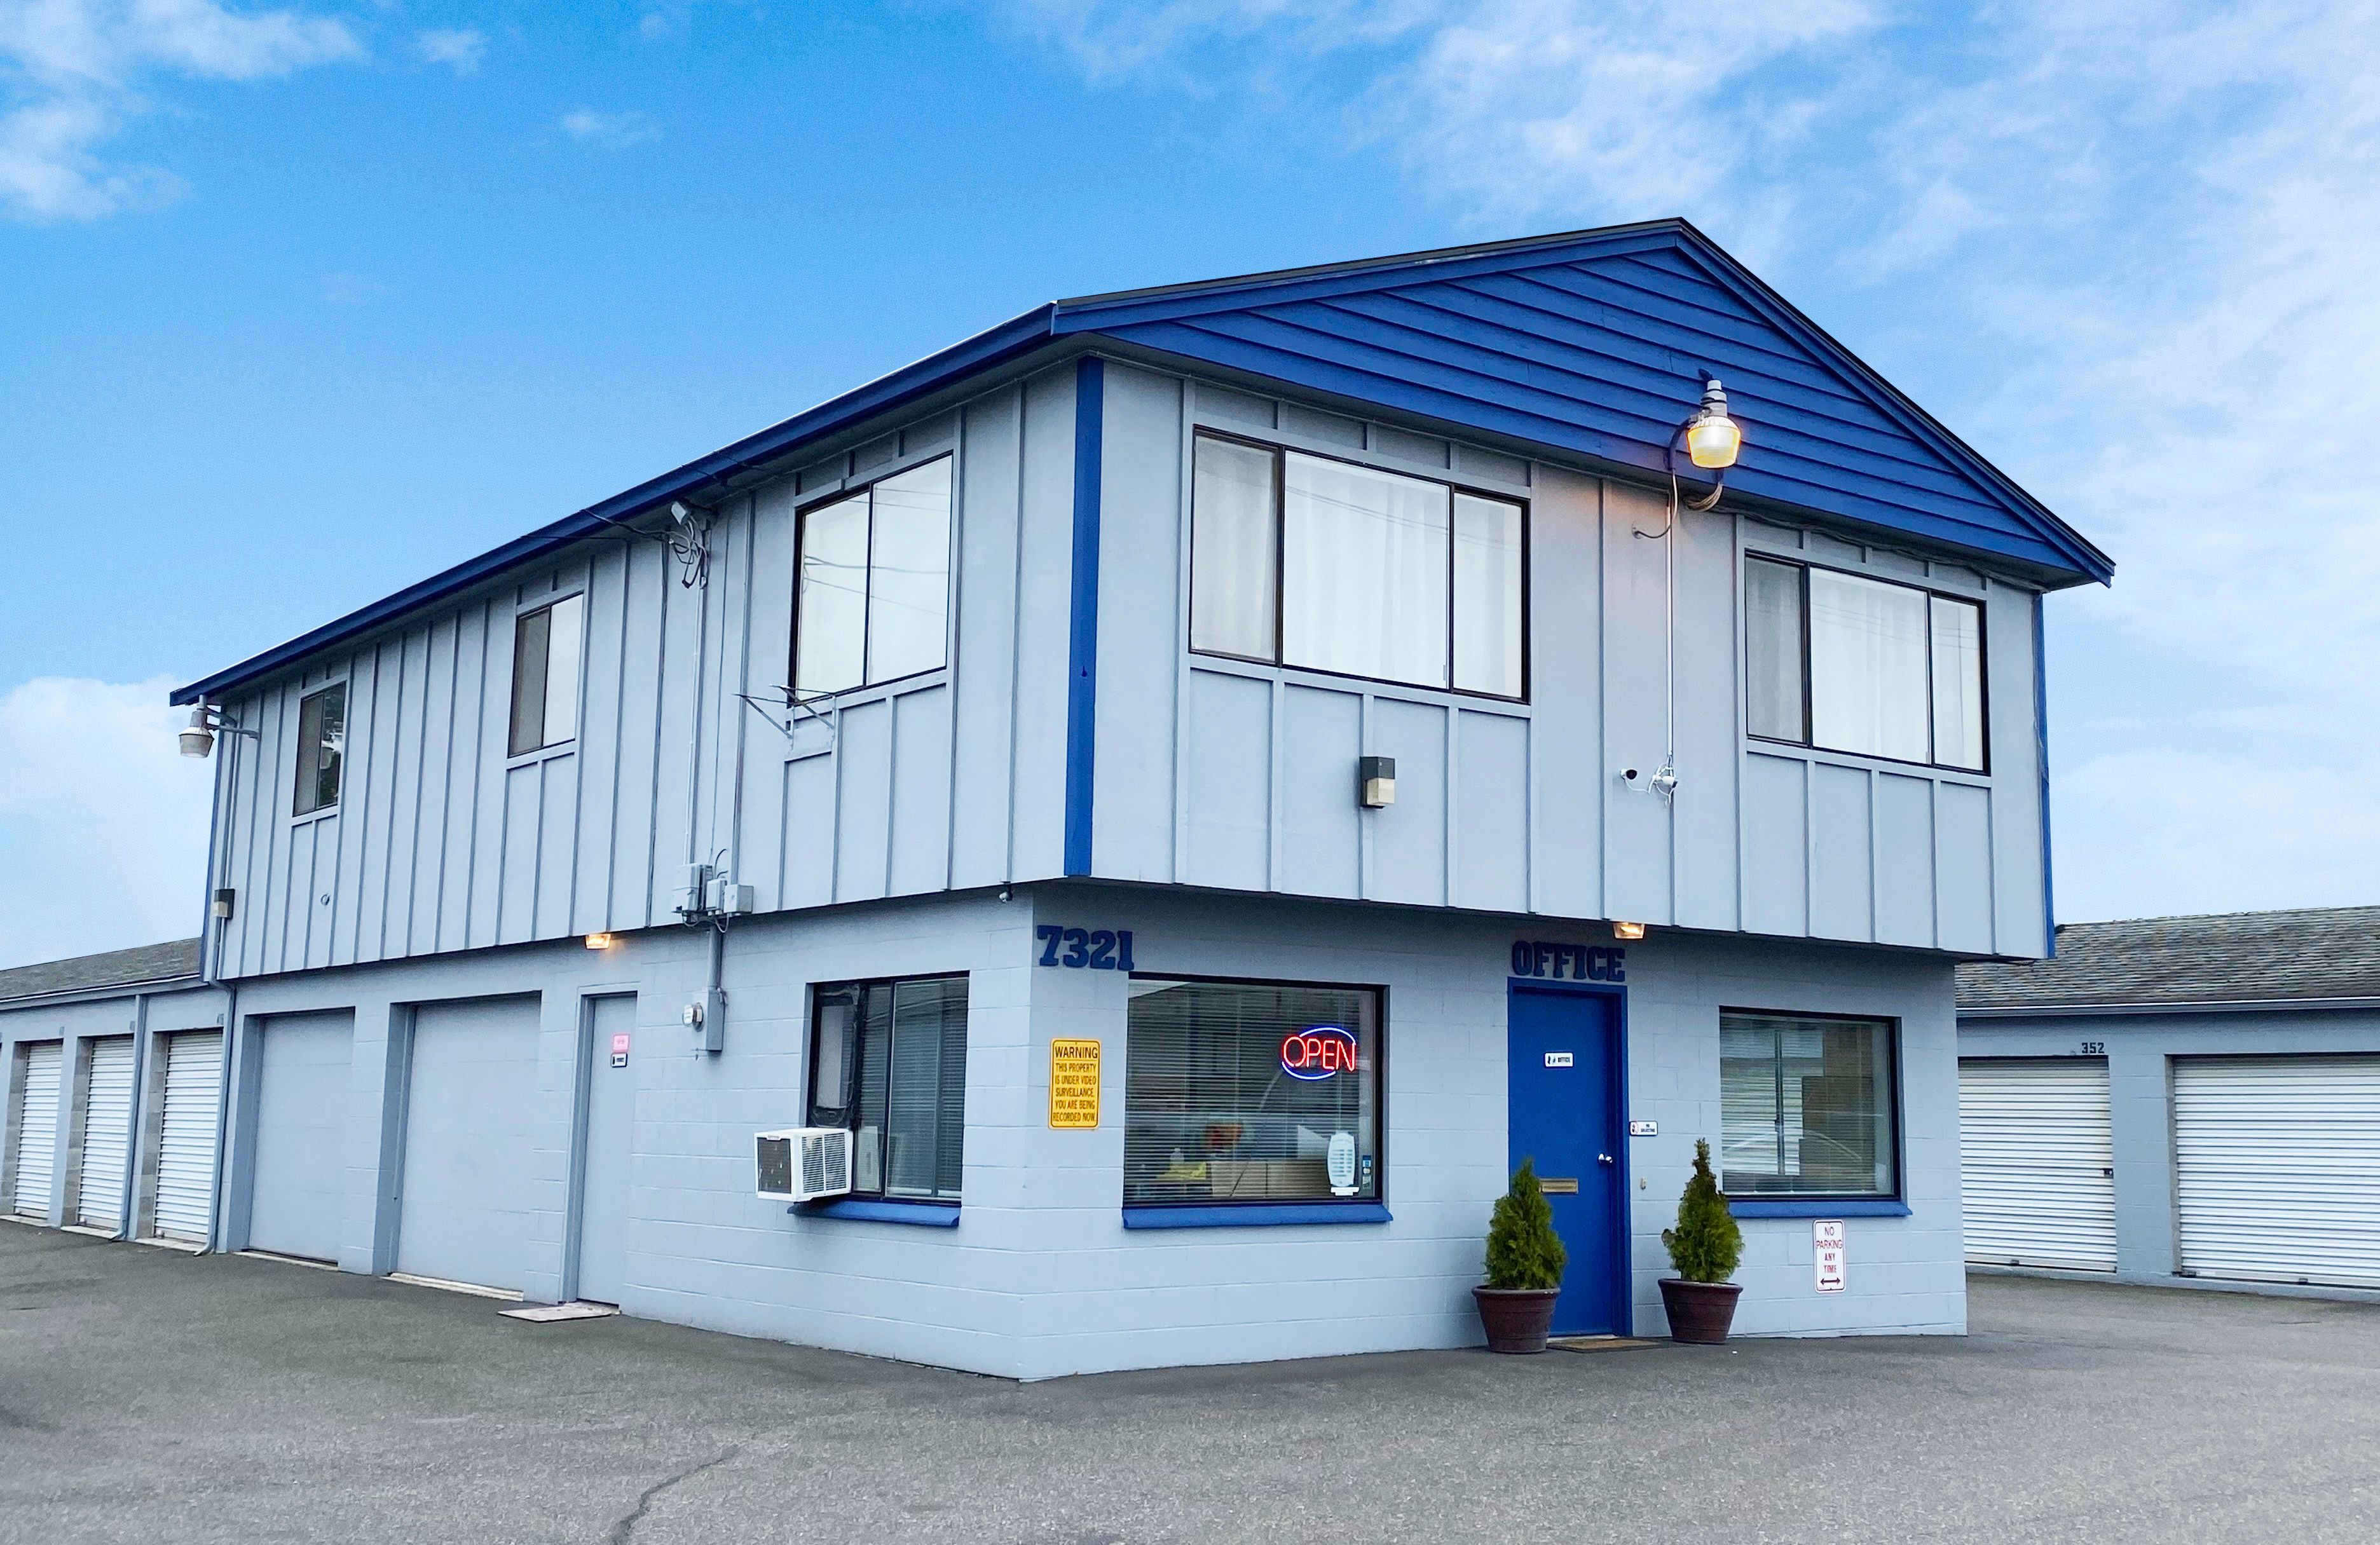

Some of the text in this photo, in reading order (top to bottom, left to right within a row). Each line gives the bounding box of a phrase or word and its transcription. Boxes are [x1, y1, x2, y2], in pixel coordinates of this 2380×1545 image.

[1037, 925, 1134, 970] 7321
[1512, 941, 1625, 982] OFFICE
[1055, 1046, 1098, 1059] WARNING
[2081, 1042, 2105, 1054] 352
[1283, 1037, 1355, 1072] OPEN
[1056, 1063, 1097, 1073] THIS PROPERTY
[1055, 1075, 1097, 1086] IS UNDER VIDEO
[1055, 1099, 1095, 1110] YOU ARE BEING
[1053, 1112, 1081, 1122] RECORDED
[1824, 1227, 1835, 1236] NO
[1816, 1240, 1843, 1249] PARKING
[1824, 1253, 1835, 1261] ANY
[1824, 1265, 1837, 1273] TIME
